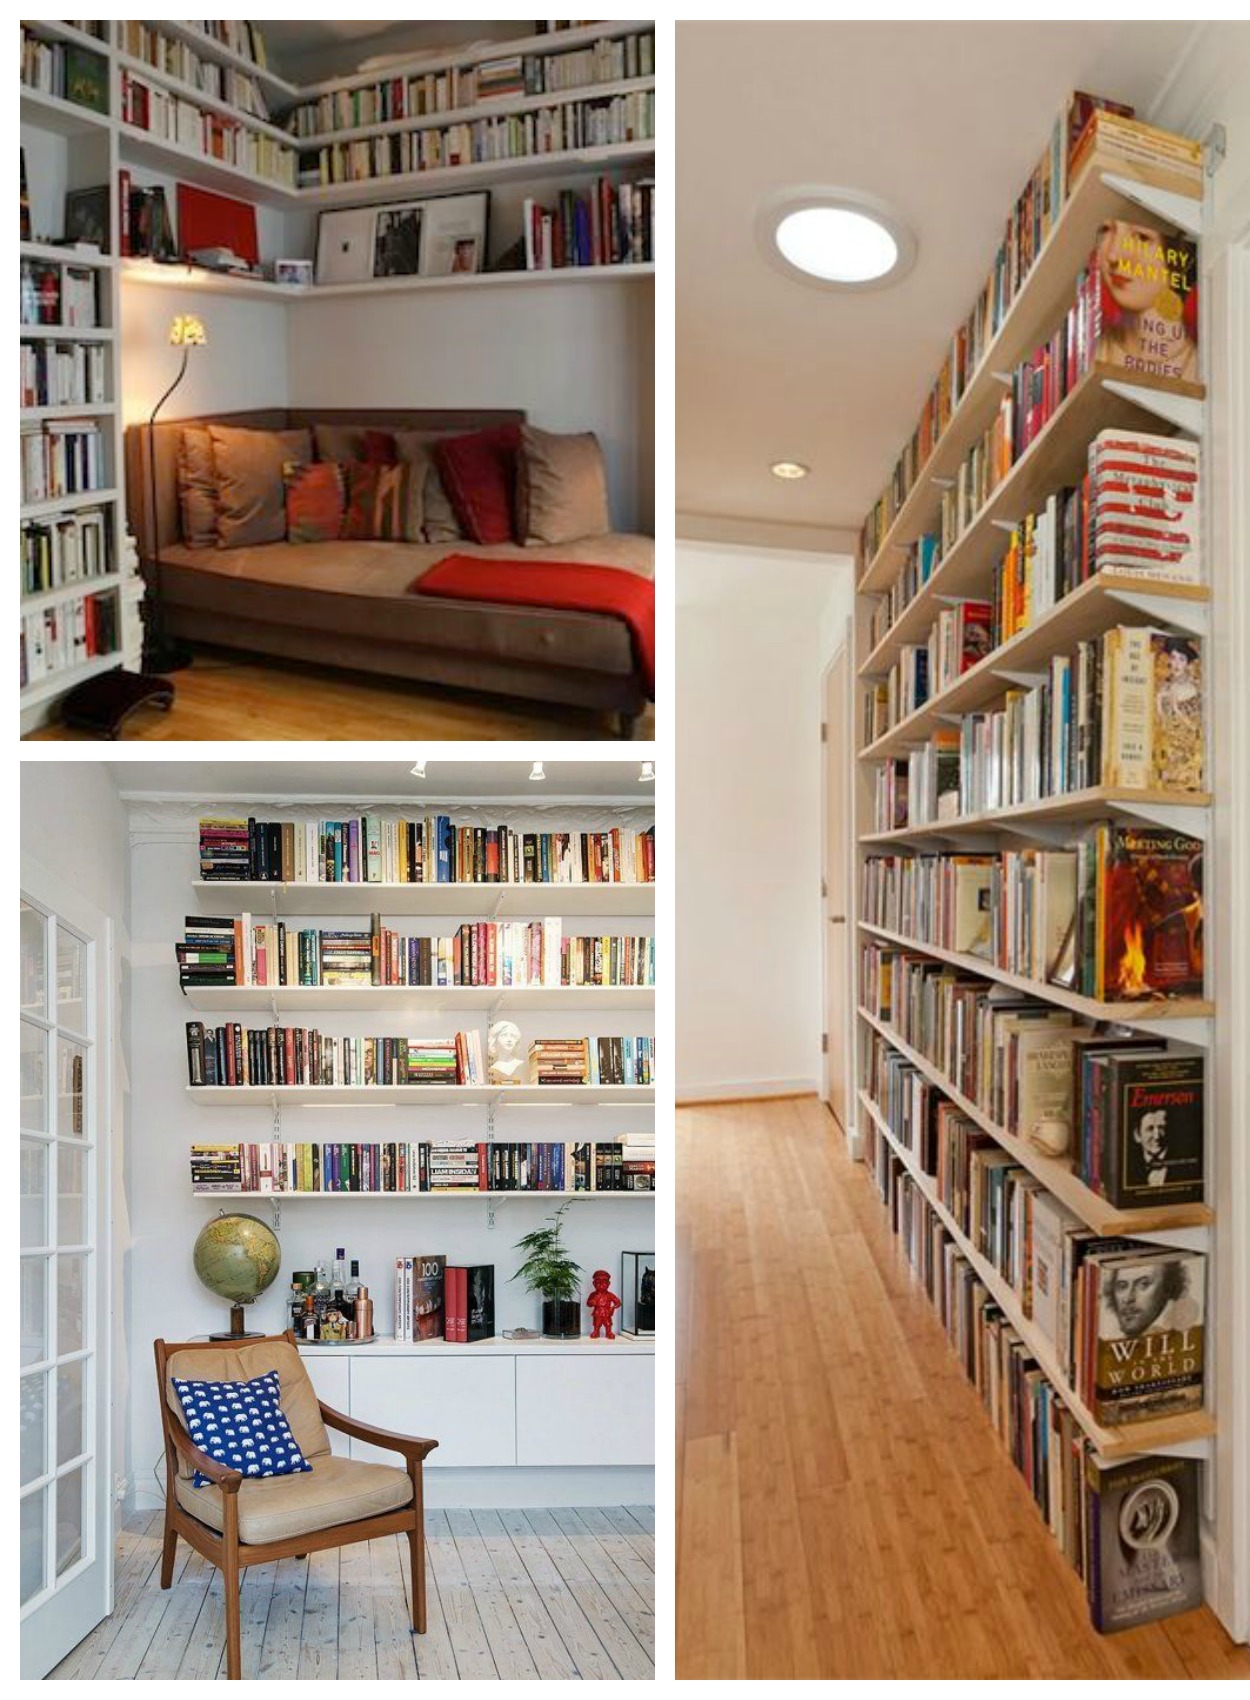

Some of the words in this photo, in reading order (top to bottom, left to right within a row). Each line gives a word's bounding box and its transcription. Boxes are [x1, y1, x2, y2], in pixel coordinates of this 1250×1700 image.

[1121, 237, 1189, 268] HILARY
[1118, 259, 1191, 291] MANTEL
[1139, 337, 1169, 357] THE
[1130, 1087, 1194, 1107] Emerson
[421, 1262, 439, 1277] 100
[1110, 1330, 1196, 1363] WILL
[1108, 1358, 1196, 1385] WORLD
